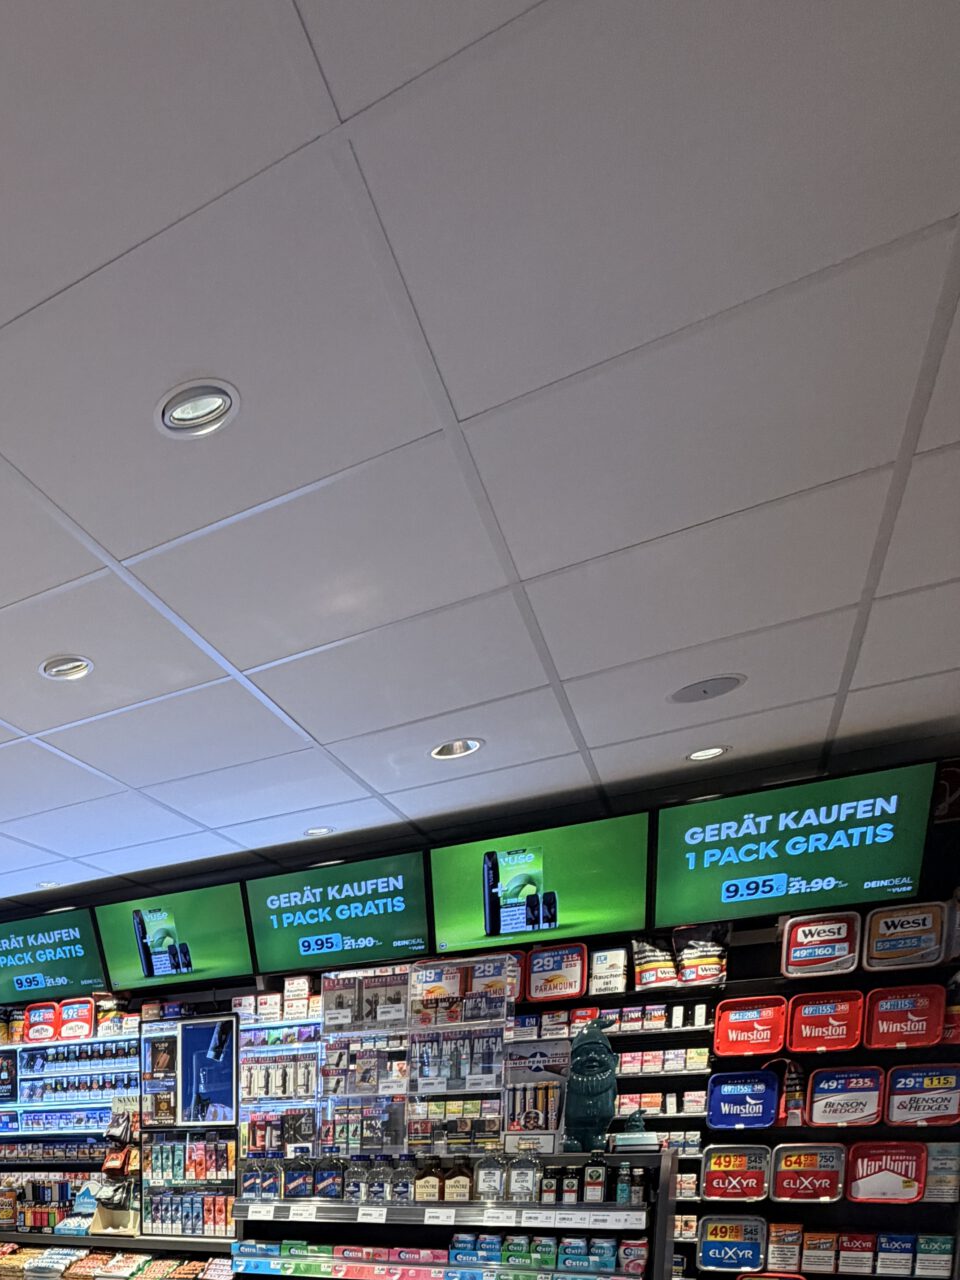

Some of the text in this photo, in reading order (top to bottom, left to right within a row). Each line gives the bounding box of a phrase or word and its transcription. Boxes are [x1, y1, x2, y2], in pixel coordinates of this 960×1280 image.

[684, 796, 898, 845] GERÄT KAUFEN
[686, 824, 894, 870] 1 PACK GRATIS
[267, 875, 403, 909] GERÄT KAUFEN
[270, 897, 405, 928] 1 PACK GRATIS
[883, 916, 929, 929] West
[27, 928, 80, 946] KAUFEN
[801, 925, 845, 939] West
[0, 951, 33, 968] PACK
[36, 945, 85, 962] GRATIS
[532, 958, 553, 972] 29
[534, 981, 578, 993] PARAMOUNT
[801, 1025, 847, 1038] Winston
[878, 1019, 926, 1033] Winston
[728, 1029, 771, 1042] Winston
[896, 1078, 914, 1088] 29
[824, 1101, 867, 1109] BENSON
[908, 1103, 950, 1112] HEDGES
[909, 1096, 945, 1105] BENSON
[720, 1102, 763, 1115] Winston
[712, 1176, 757, 1190] ELIXYR
[783, 1176, 830, 1190] ELIXYR
[709, 1247, 753, 1260] ELIXYR
